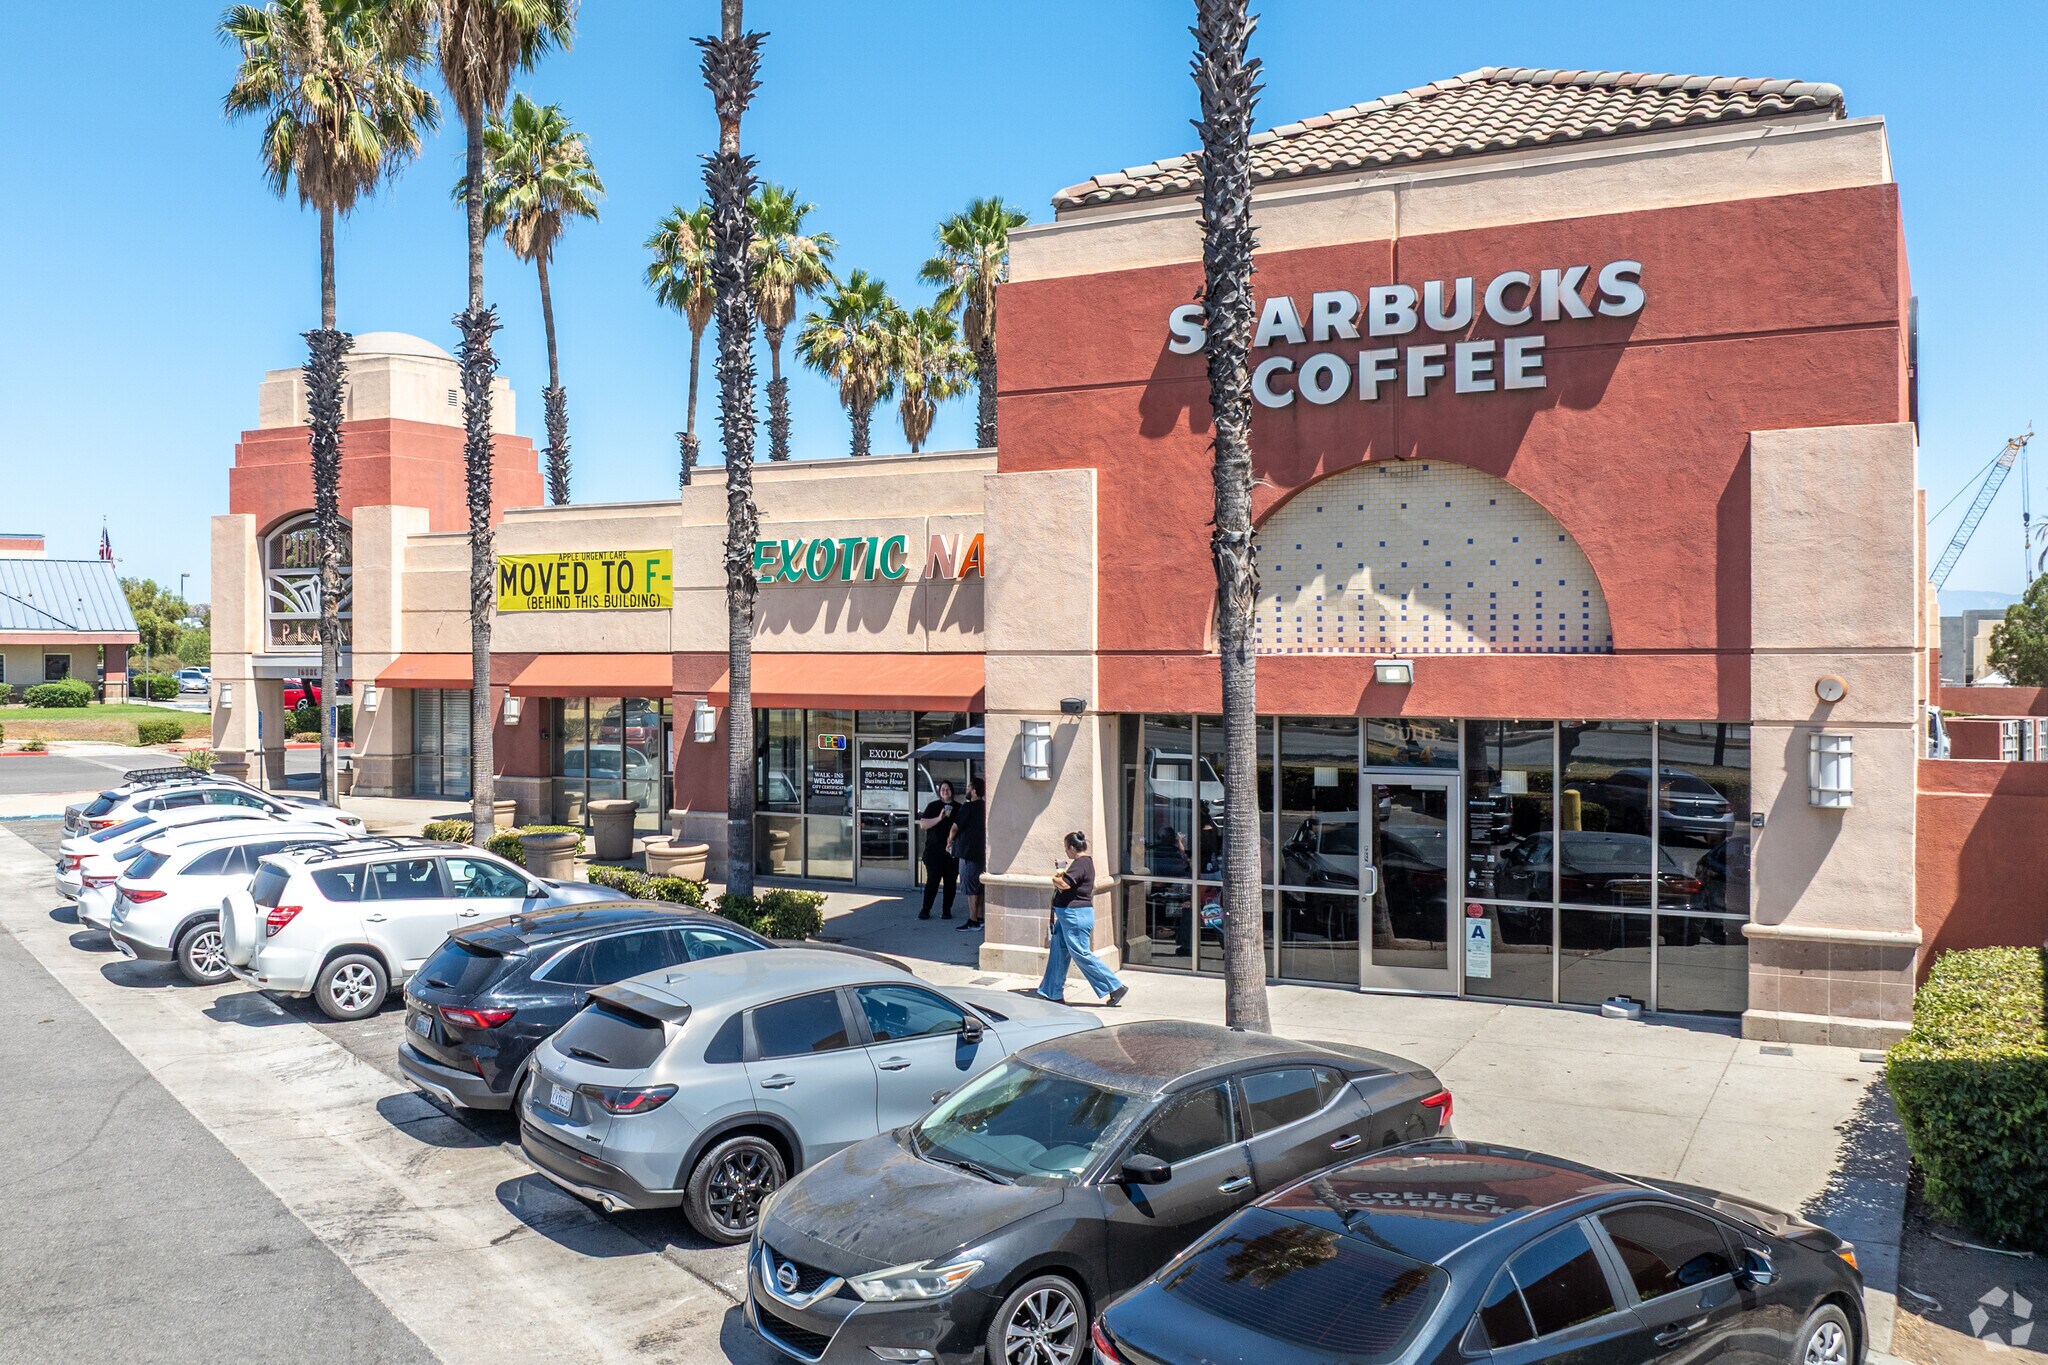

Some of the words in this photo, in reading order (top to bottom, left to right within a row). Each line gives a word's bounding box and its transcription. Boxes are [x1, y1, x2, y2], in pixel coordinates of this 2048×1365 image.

[1168, 259, 1646, 355] SARBUCKS
[1250, 335, 1547, 409] COFFEE
[558, 552, 580, 562] APPLE
[581, 551, 608, 561] URGENT
[609, 550, 627, 560] CARE
[753, 534, 908, 583] EXOTIC
[500, 561, 589, 597] MOVED
[601, 559, 634, 594] TO
[527, 595, 571, 610] (BEHIND
[575, 595, 599, 609] THIS
[604, 593, 661, 609] BUILDING)
[282, 623, 352, 643] PLAA
[869, 749, 903, 759] EXOTIC
[1471, 925, 1486, 939] A
